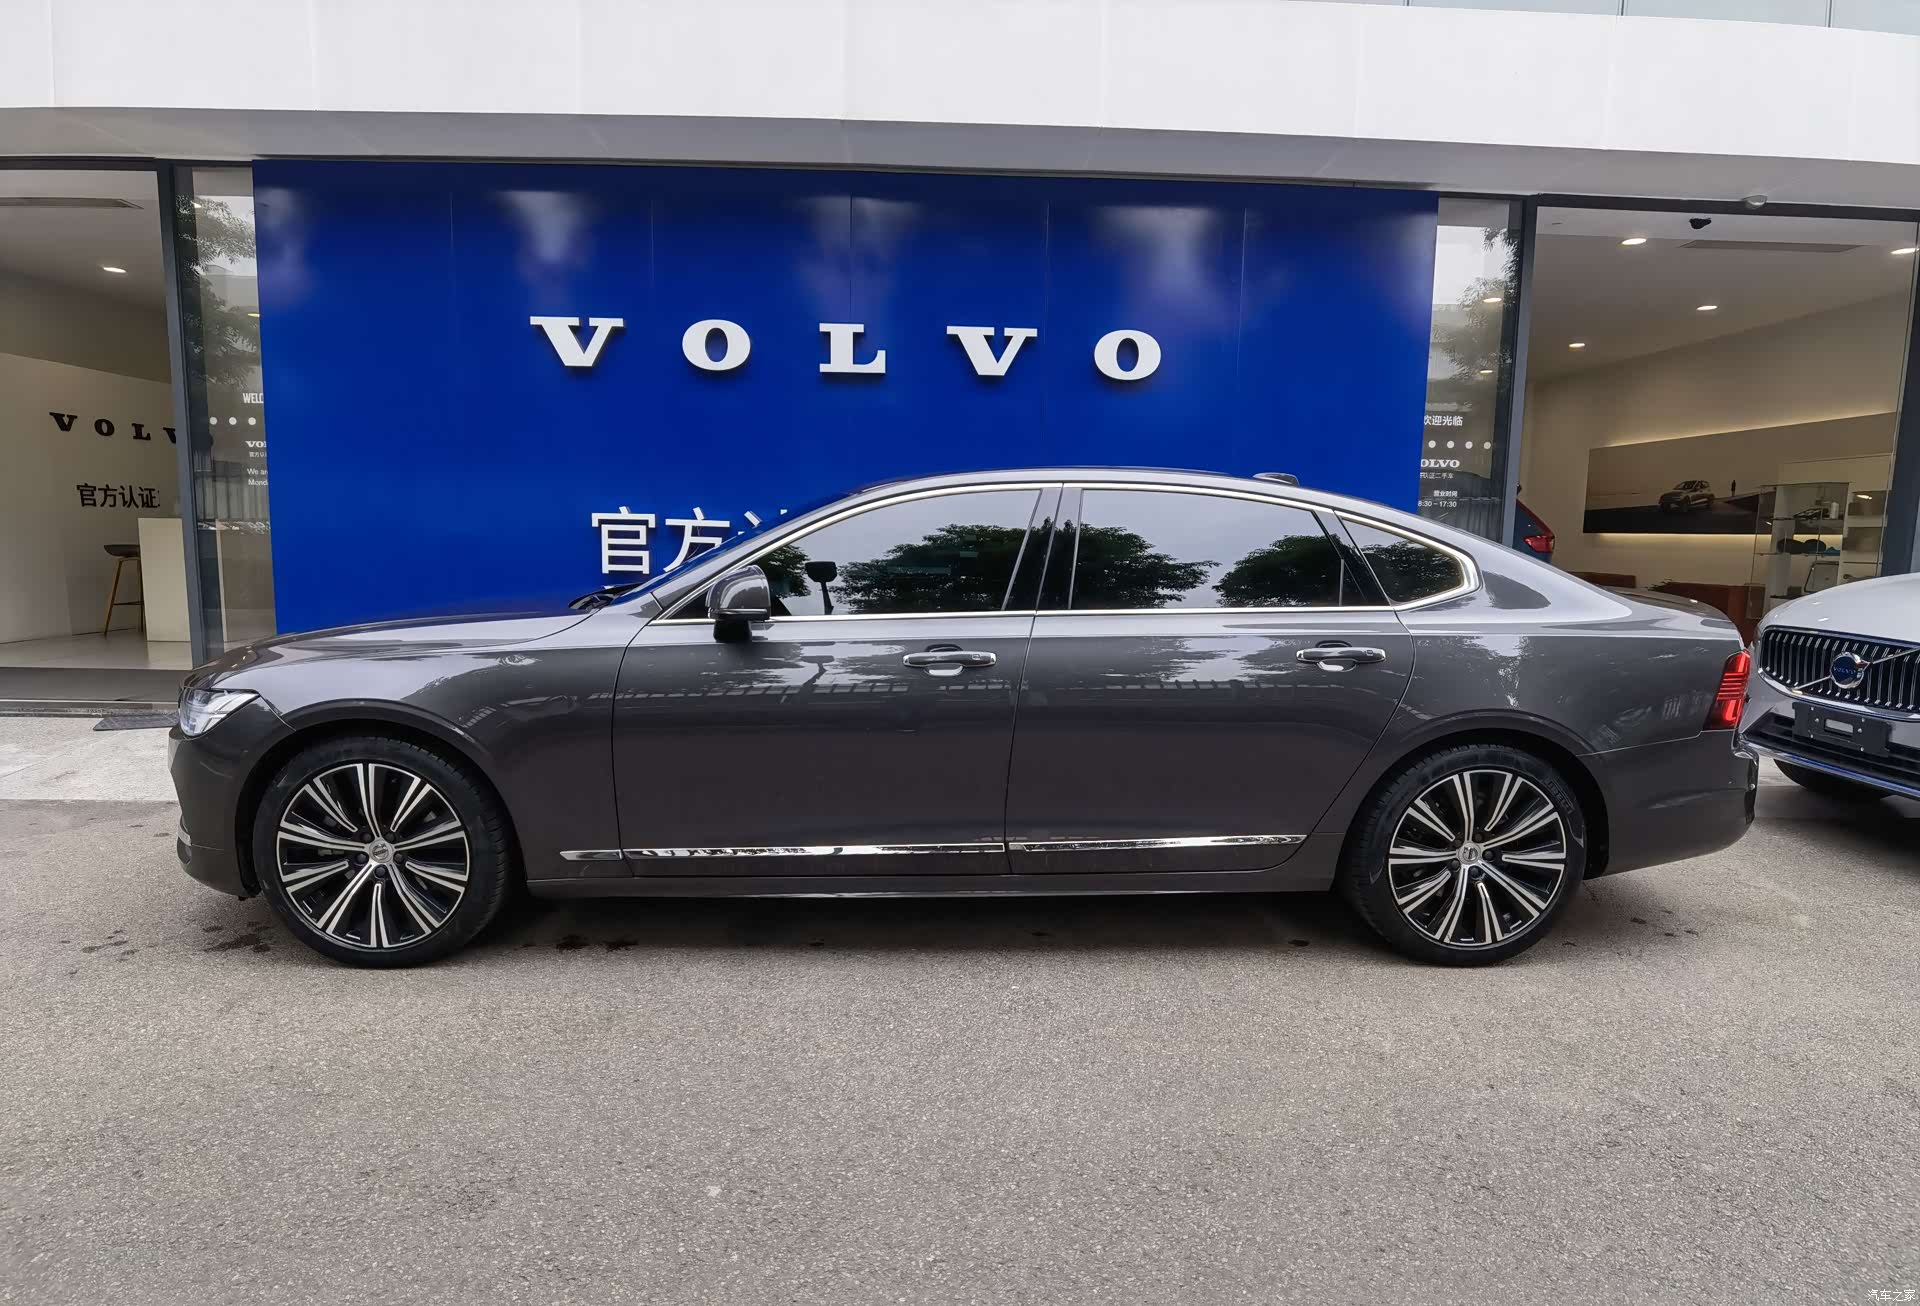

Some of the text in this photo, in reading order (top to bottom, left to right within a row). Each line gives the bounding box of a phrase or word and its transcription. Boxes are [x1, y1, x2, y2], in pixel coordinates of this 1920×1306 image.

[529, 315, 1162, 382] VOLVO
[76, 482, 161, 509] 官方认证
[591, 505, 788, 575] 官方
